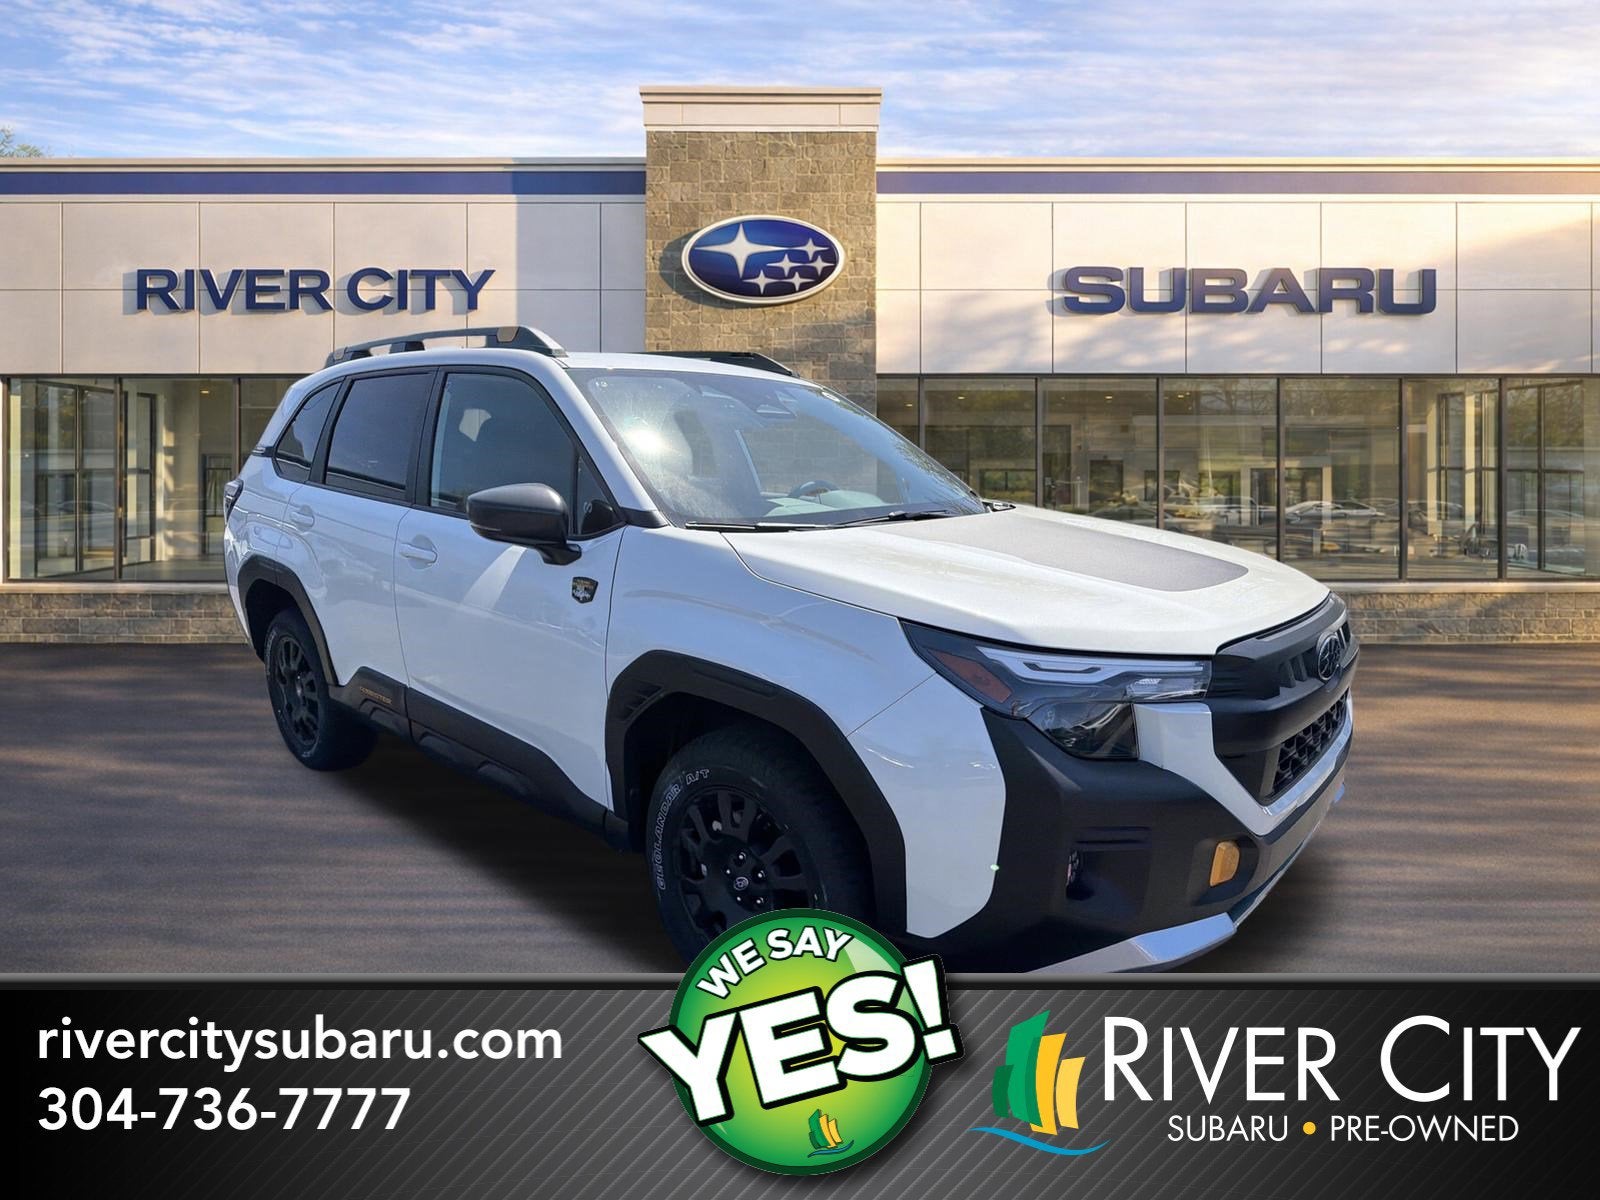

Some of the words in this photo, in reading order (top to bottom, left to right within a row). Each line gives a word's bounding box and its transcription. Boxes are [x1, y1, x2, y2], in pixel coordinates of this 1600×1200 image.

[136, 269, 332, 311] RIVER
[347, 268, 496, 311] CITY
[1063, 266, 1437, 315] SUBARU
